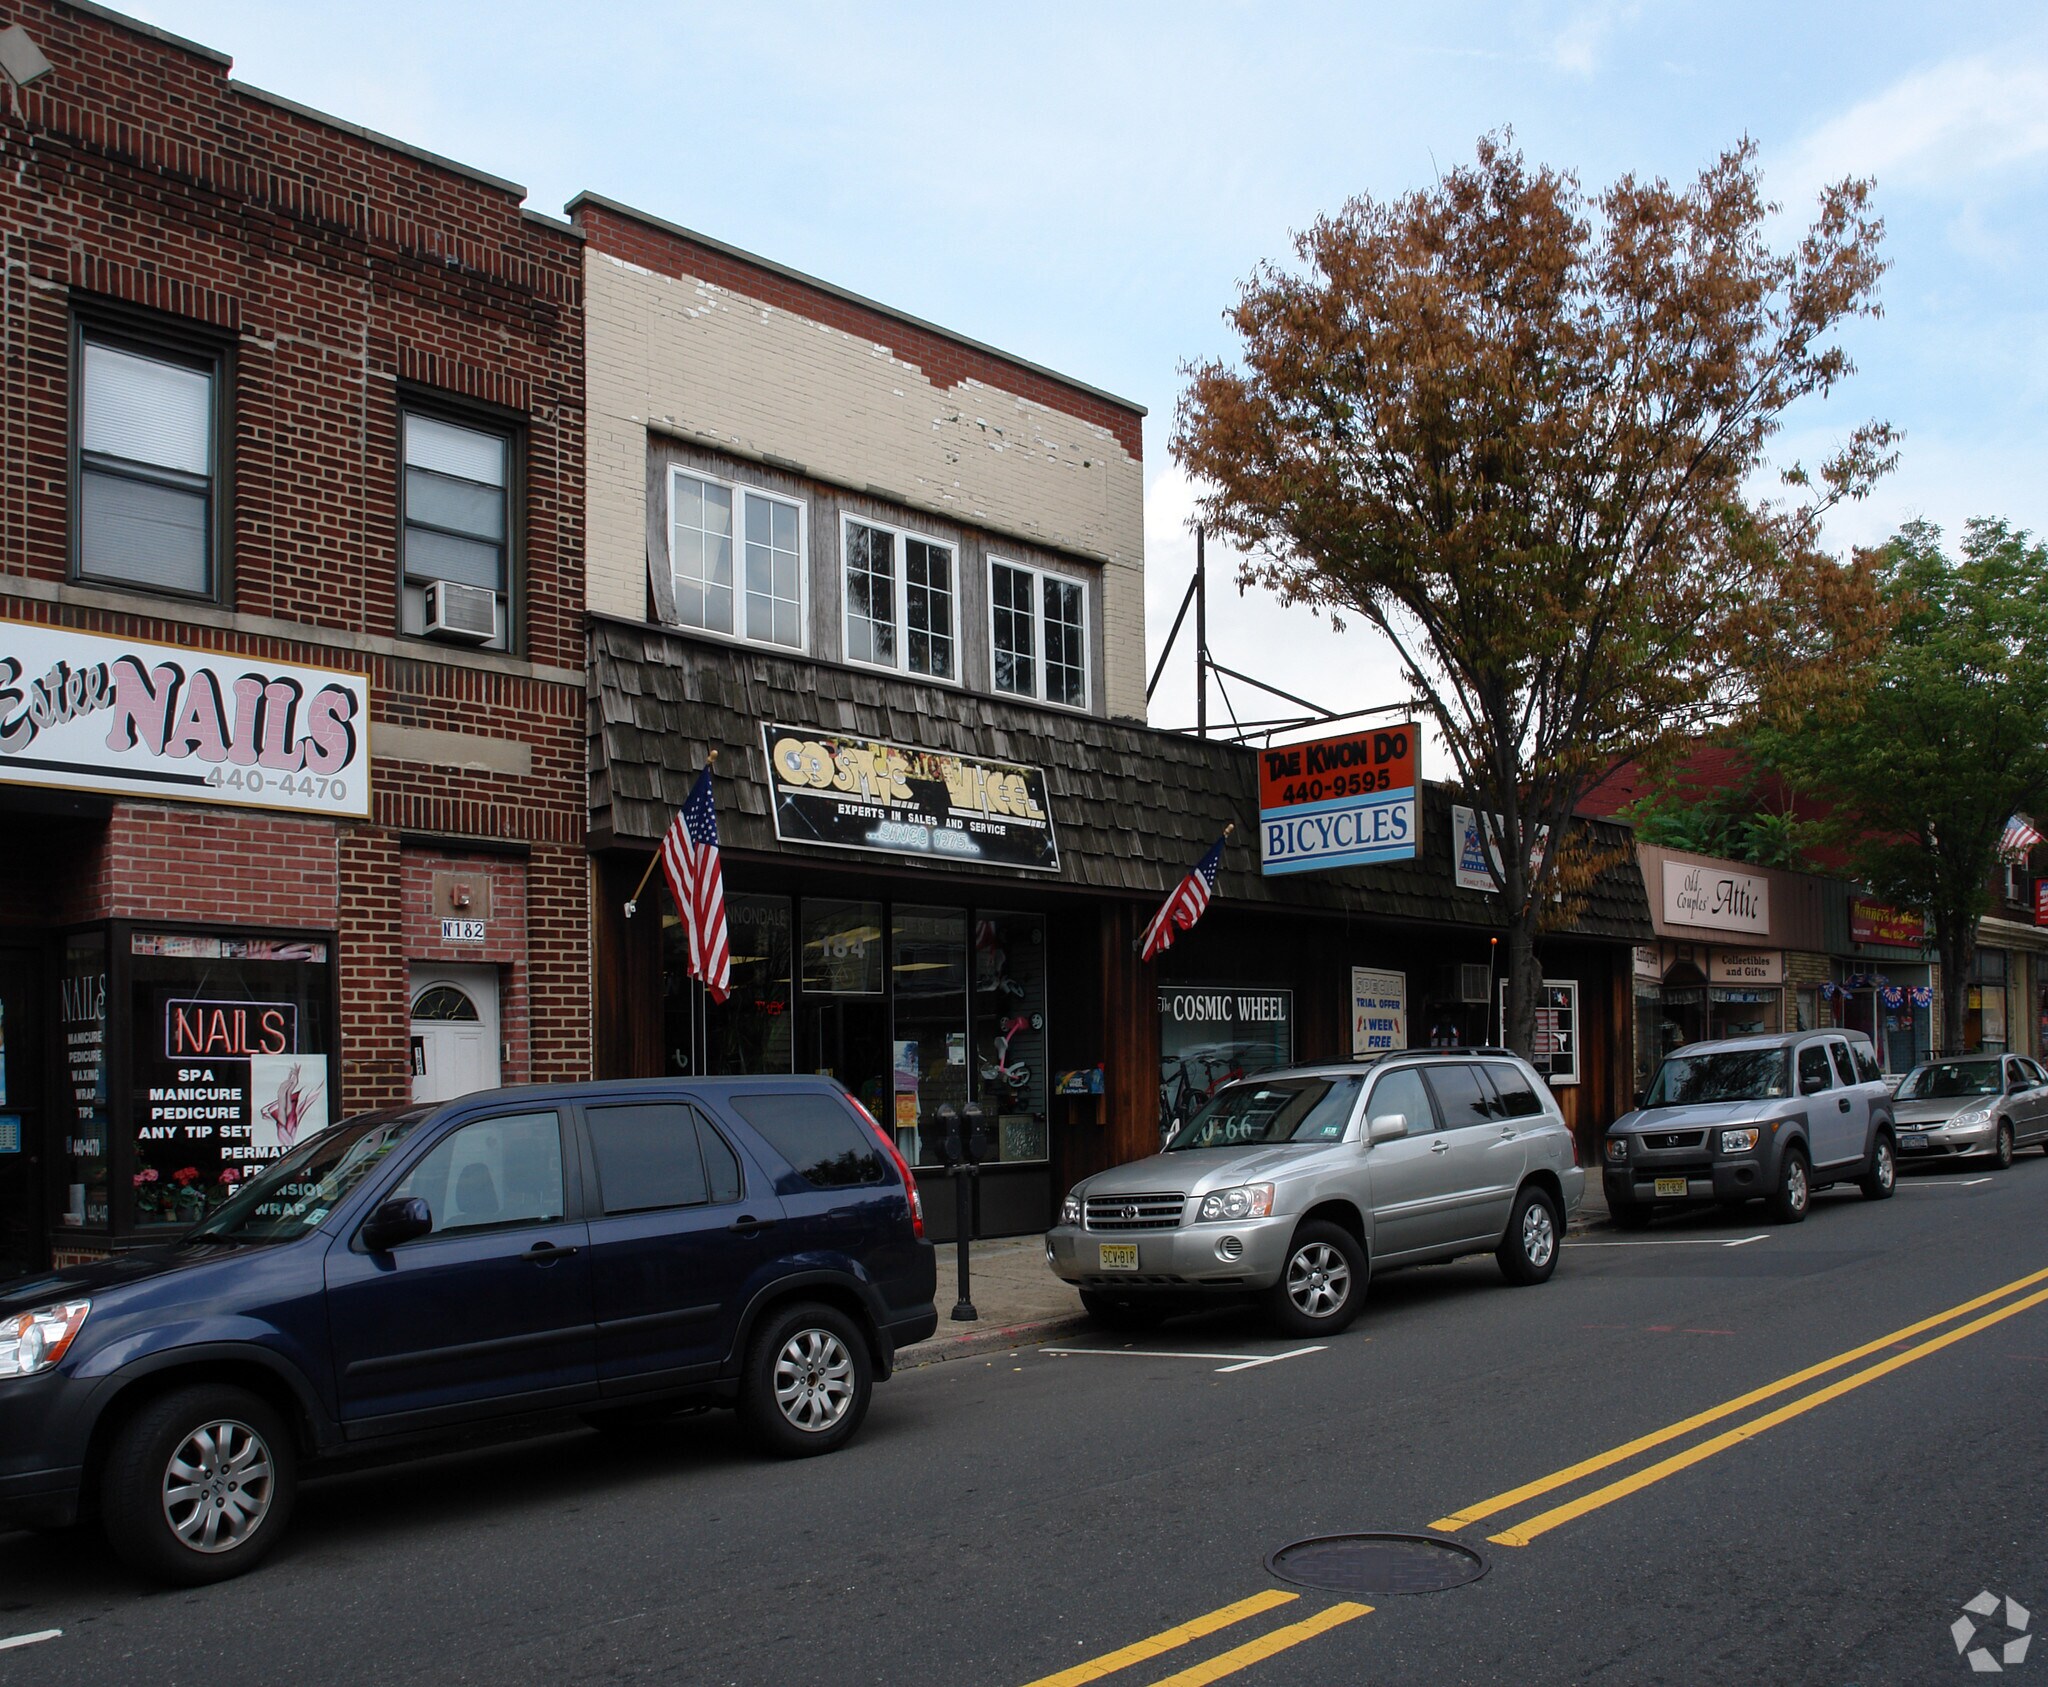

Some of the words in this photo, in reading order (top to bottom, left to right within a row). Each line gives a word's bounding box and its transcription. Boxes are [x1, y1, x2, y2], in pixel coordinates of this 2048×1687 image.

[105, 654, 358, 775] NAILS
[1265, 751, 1301, 782] TAE
[1306, 740, 1367, 775] KWON
[1373, 733, 1408, 764] DO
[206, 766, 347, 801] 440-4470
[940, 756, 1046, 820] WHEEL
[1283, 769, 1390, 804] 440-9595
[838, 803, 885, 819] EXPERTS
[891, 810, 901, 821] IN
[908, 812, 938, 826] SALES
[945, 818, 963, 830] AND
[969, 821, 1006, 836] SERVICE
[1267, 806, 1408, 856] BICYCLES
[1685, 869, 1700, 892] Old
[1712, 879, 1759, 919] Attic
[822, 935, 865, 959] 184
[1722, 954, 1770, 966] Collectibles
[1726, 967, 1742, 976] and
[1745, 967, 1766, 977] Gifts
[1356, 977, 1401, 996] SPECIAL
[61, 973, 106, 1022] NAILS
[1357, 998, 1376, 1008] TRIAL
[1379, 1000, 1401, 1010] OFFER
[1173, 995, 1232, 1021] COSMIC
[1238, 997, 1286, 1021] WHEEL
[175, 1007, 287, 1055] NAILS
[1368, 1018, 1393, 1031] WEEK
[67, 1031, 103, 1045] MANICURE
[1368, 1035, 1392, 1048] FREE
[68, 1050, 103, 1063] PEDICURE
[71, 1069, 100, 1082] WAXING
[178, 1069, 214, 1082] SPA
[75, 1088, 96, 1100] WRAP
[150, 1088, 242, 1101] MANICURE
[78, 1107, 94, 1119] TIPS
[151, 1107, 240, 1120] PEDICURE
[138, 1126, 177, 1139] ANY
[185, 1126, 213, 1138] TIP
[220, 1125, 252, 1137] SET
[255, 1203, 307, 1216] WRAP
